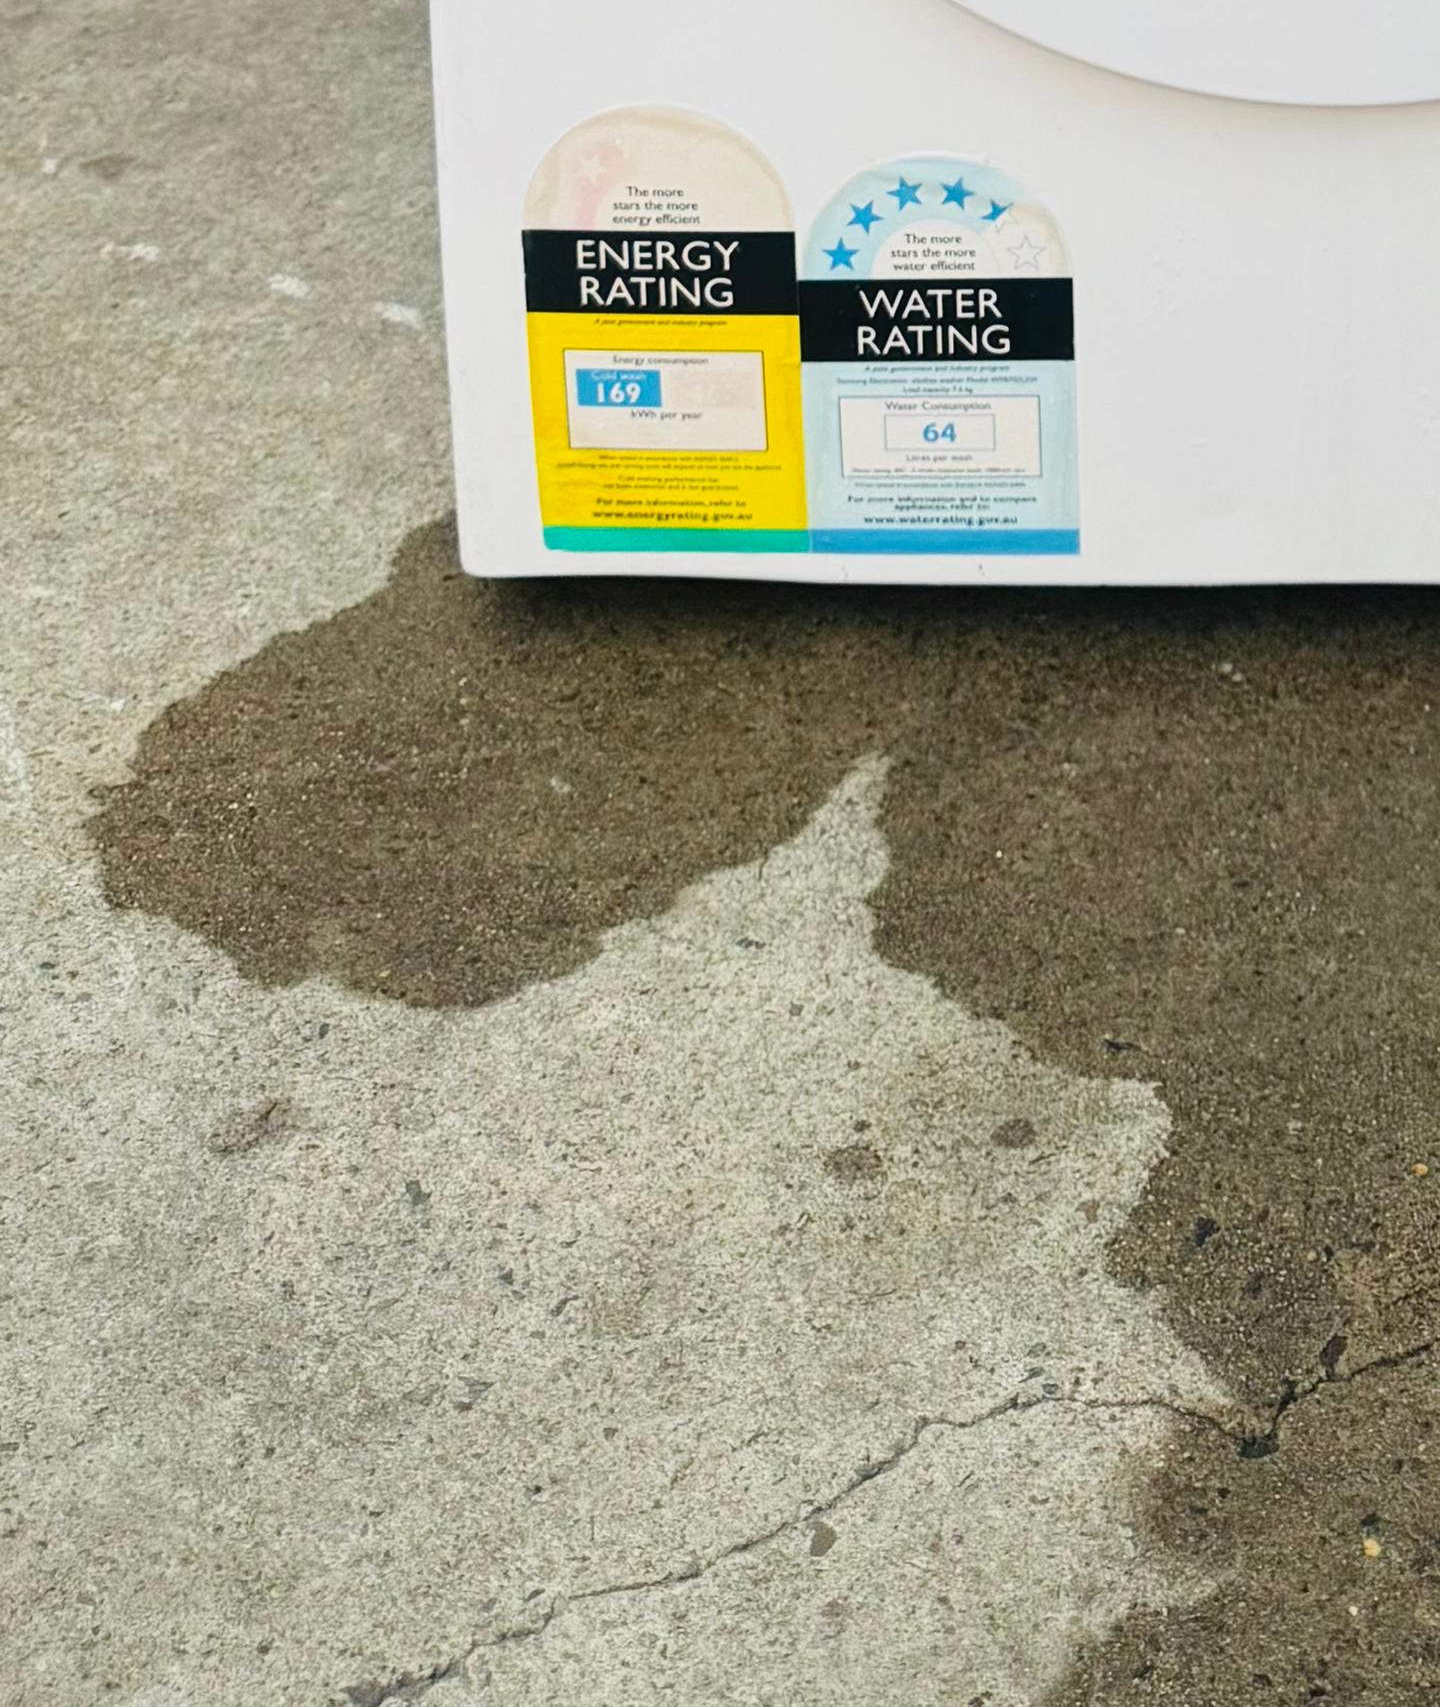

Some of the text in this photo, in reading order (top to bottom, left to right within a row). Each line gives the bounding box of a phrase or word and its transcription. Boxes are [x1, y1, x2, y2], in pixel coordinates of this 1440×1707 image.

[627, 187, 684, 198] The more
[613, 200, 698, 211] stars the more
[612, 214, 701, 226] energy efficient
[904, 234, 962, 245] The more
[575, 240, 739, 272] ENERGY
[891, 247, 976, 259] stars the more
[893, 260, 976, 272] water efficient
[579, 276, 735, 308] RATING
[858, 288, 1003, 319] WATER
[857, 324, 1011, 356] RATING
[613, 355, 709, 366] Energy consumption
[596, 382, 641, 403] 169
[885, 401, 991, 412] Water Consumption
[660, 412, 677, 421] per
[681, 412, 703, 421] year
[923, 422, 956, 442] 64
